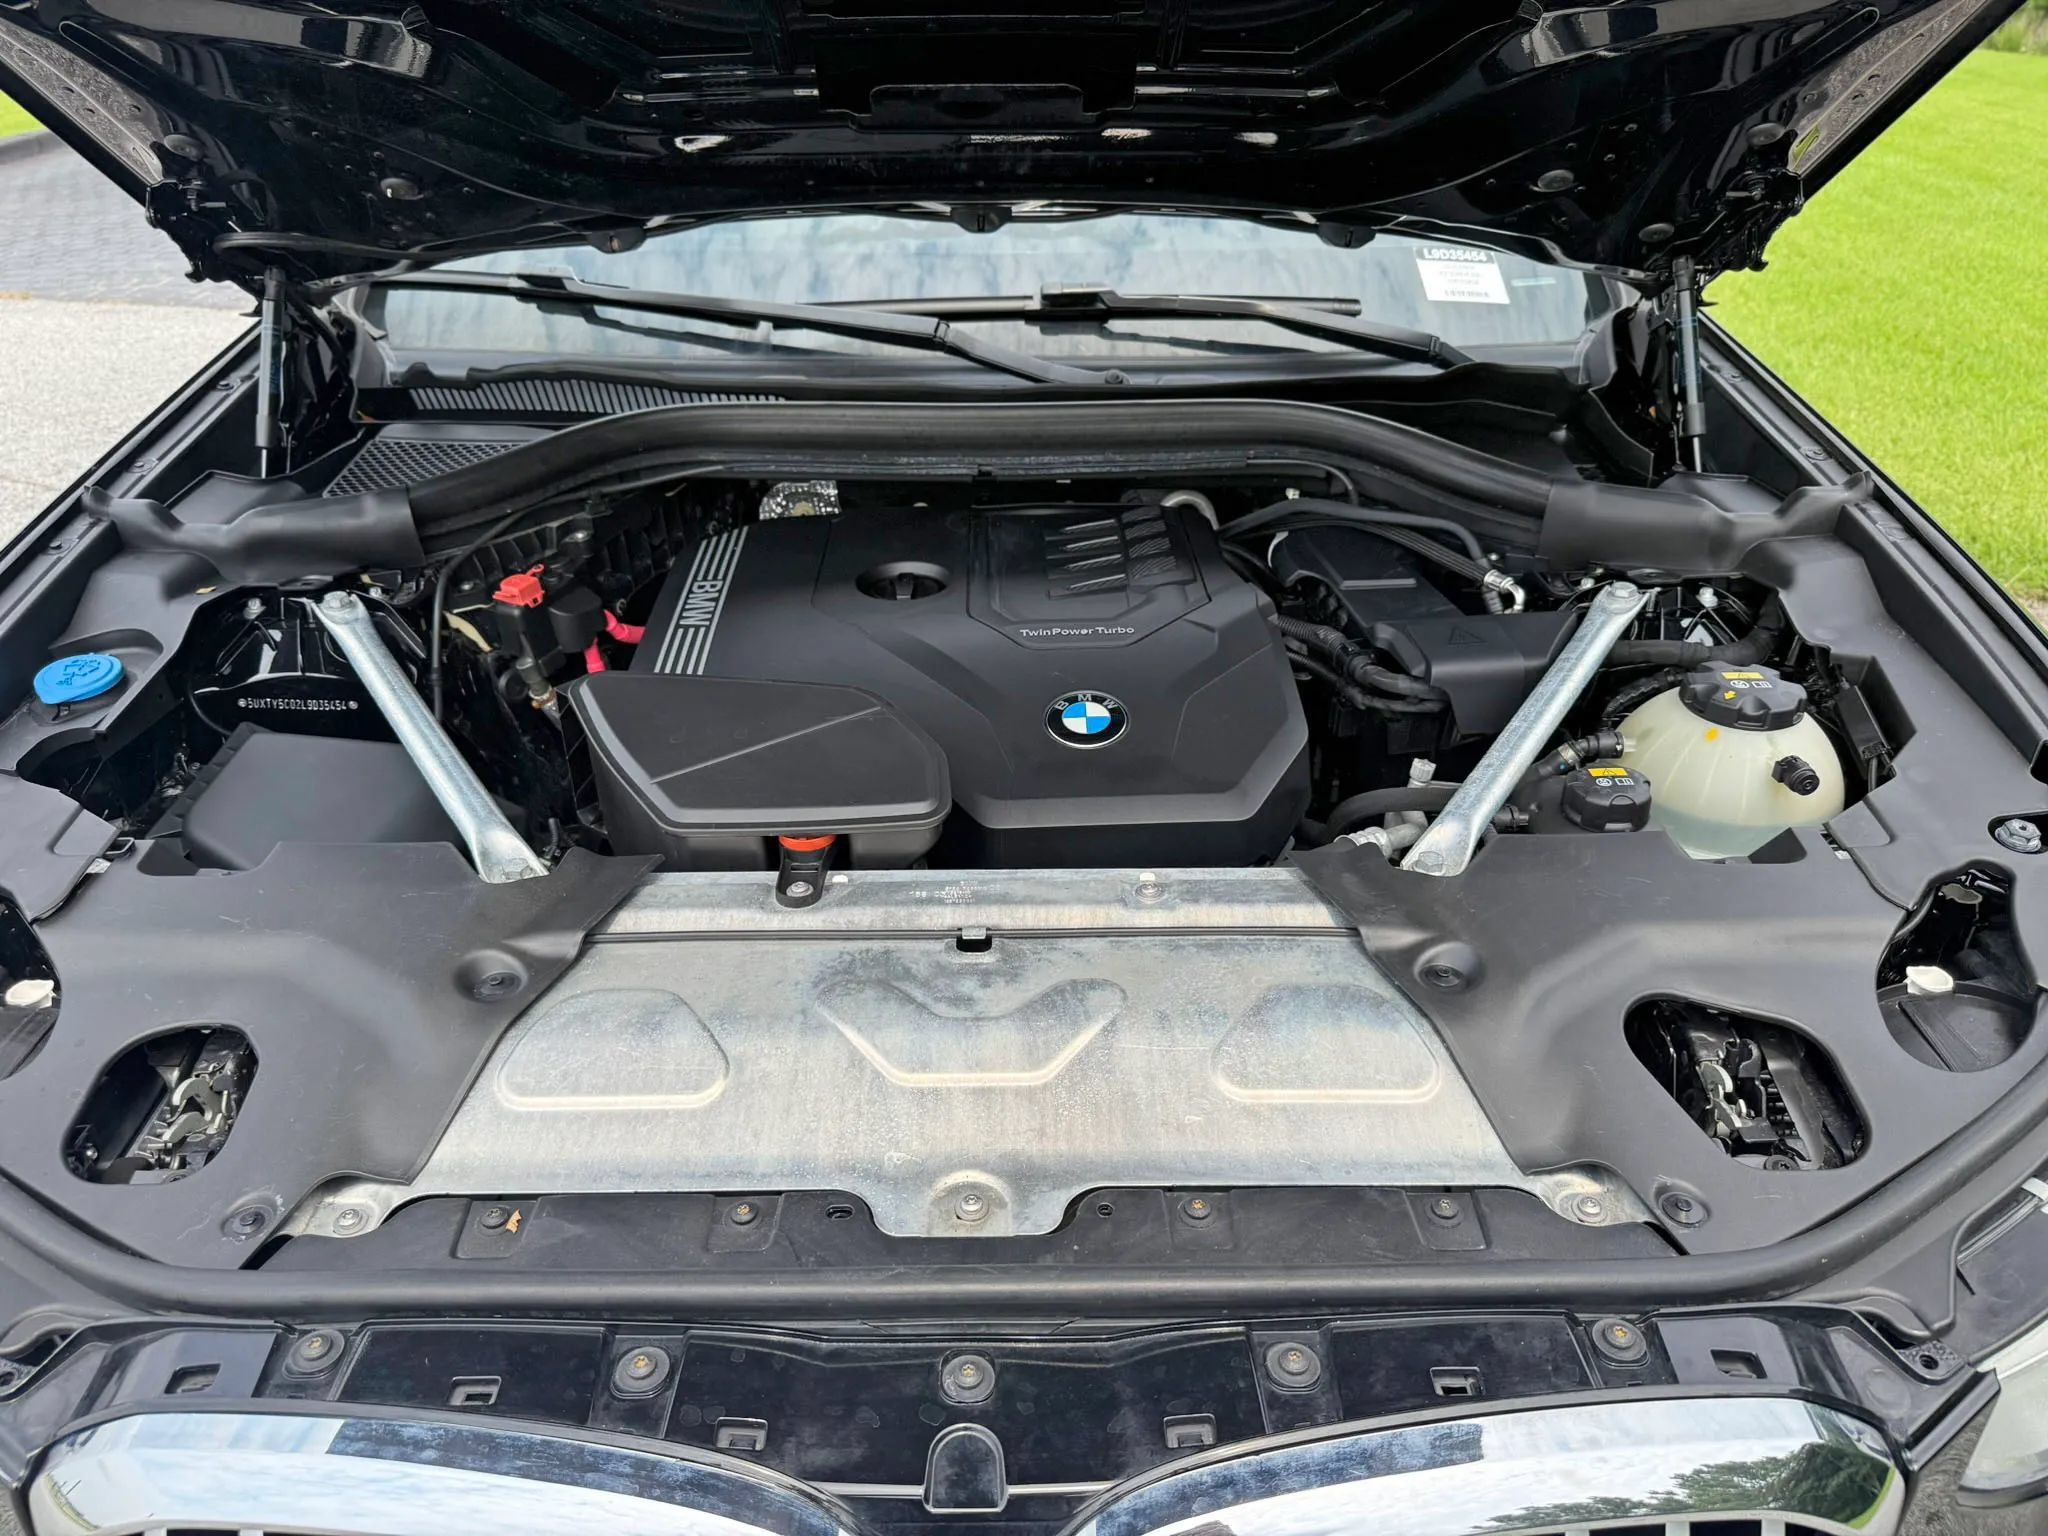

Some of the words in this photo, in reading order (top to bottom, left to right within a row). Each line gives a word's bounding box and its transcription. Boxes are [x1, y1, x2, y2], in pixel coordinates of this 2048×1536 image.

[679, 580, 724, 626] BMW
[1095, 626, 1135, 635] Turbo
[1053, 693, 1119, 711] BMW
